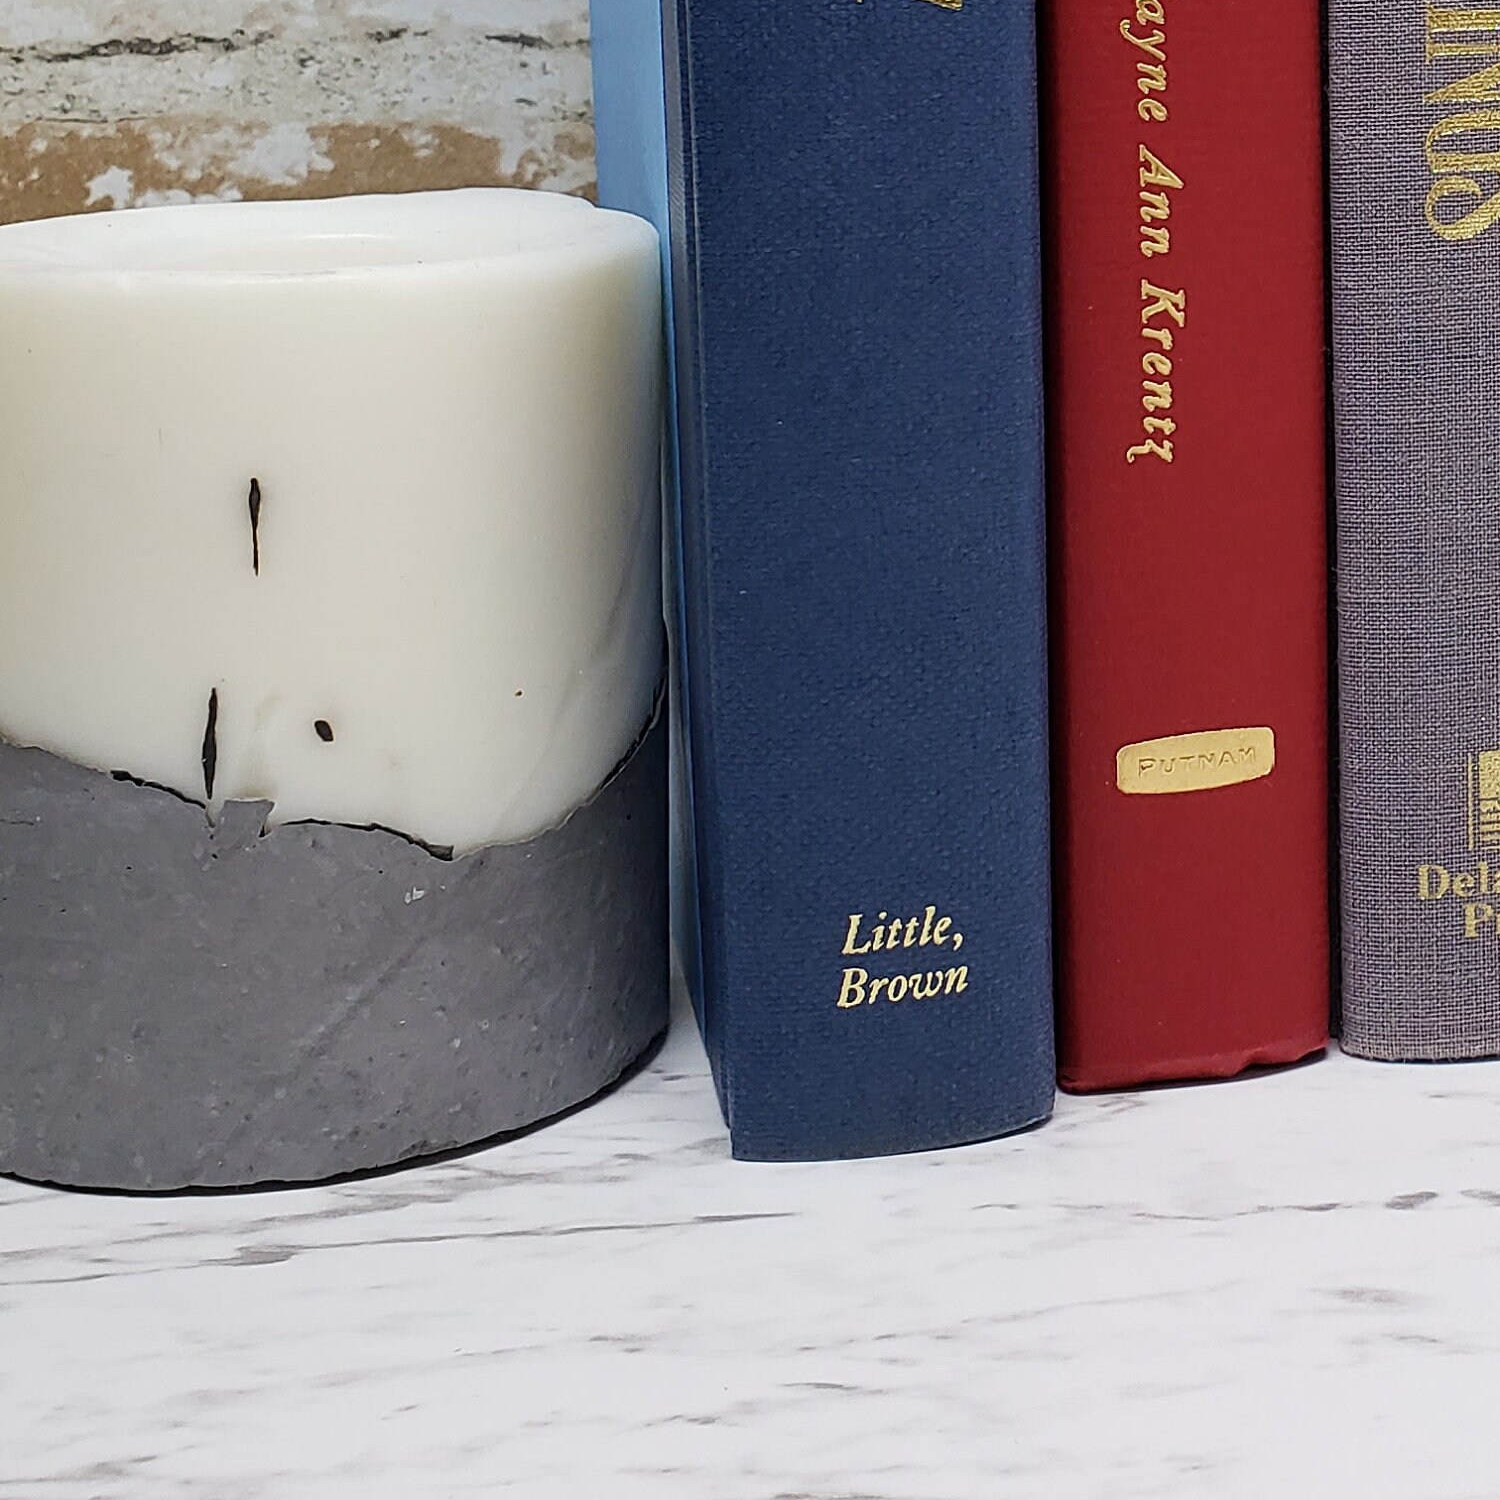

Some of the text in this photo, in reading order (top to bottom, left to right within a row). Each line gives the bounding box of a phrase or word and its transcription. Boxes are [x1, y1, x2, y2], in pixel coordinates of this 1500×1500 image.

[1137, 142, 1185, 260] Ann
[1125, 277, 1187, 466] Krentz
[1137, 746, 1257, 779] PUTNAM
[842, 905, 964, 955] Little,
[836, 963, 969, 1009] Brown
